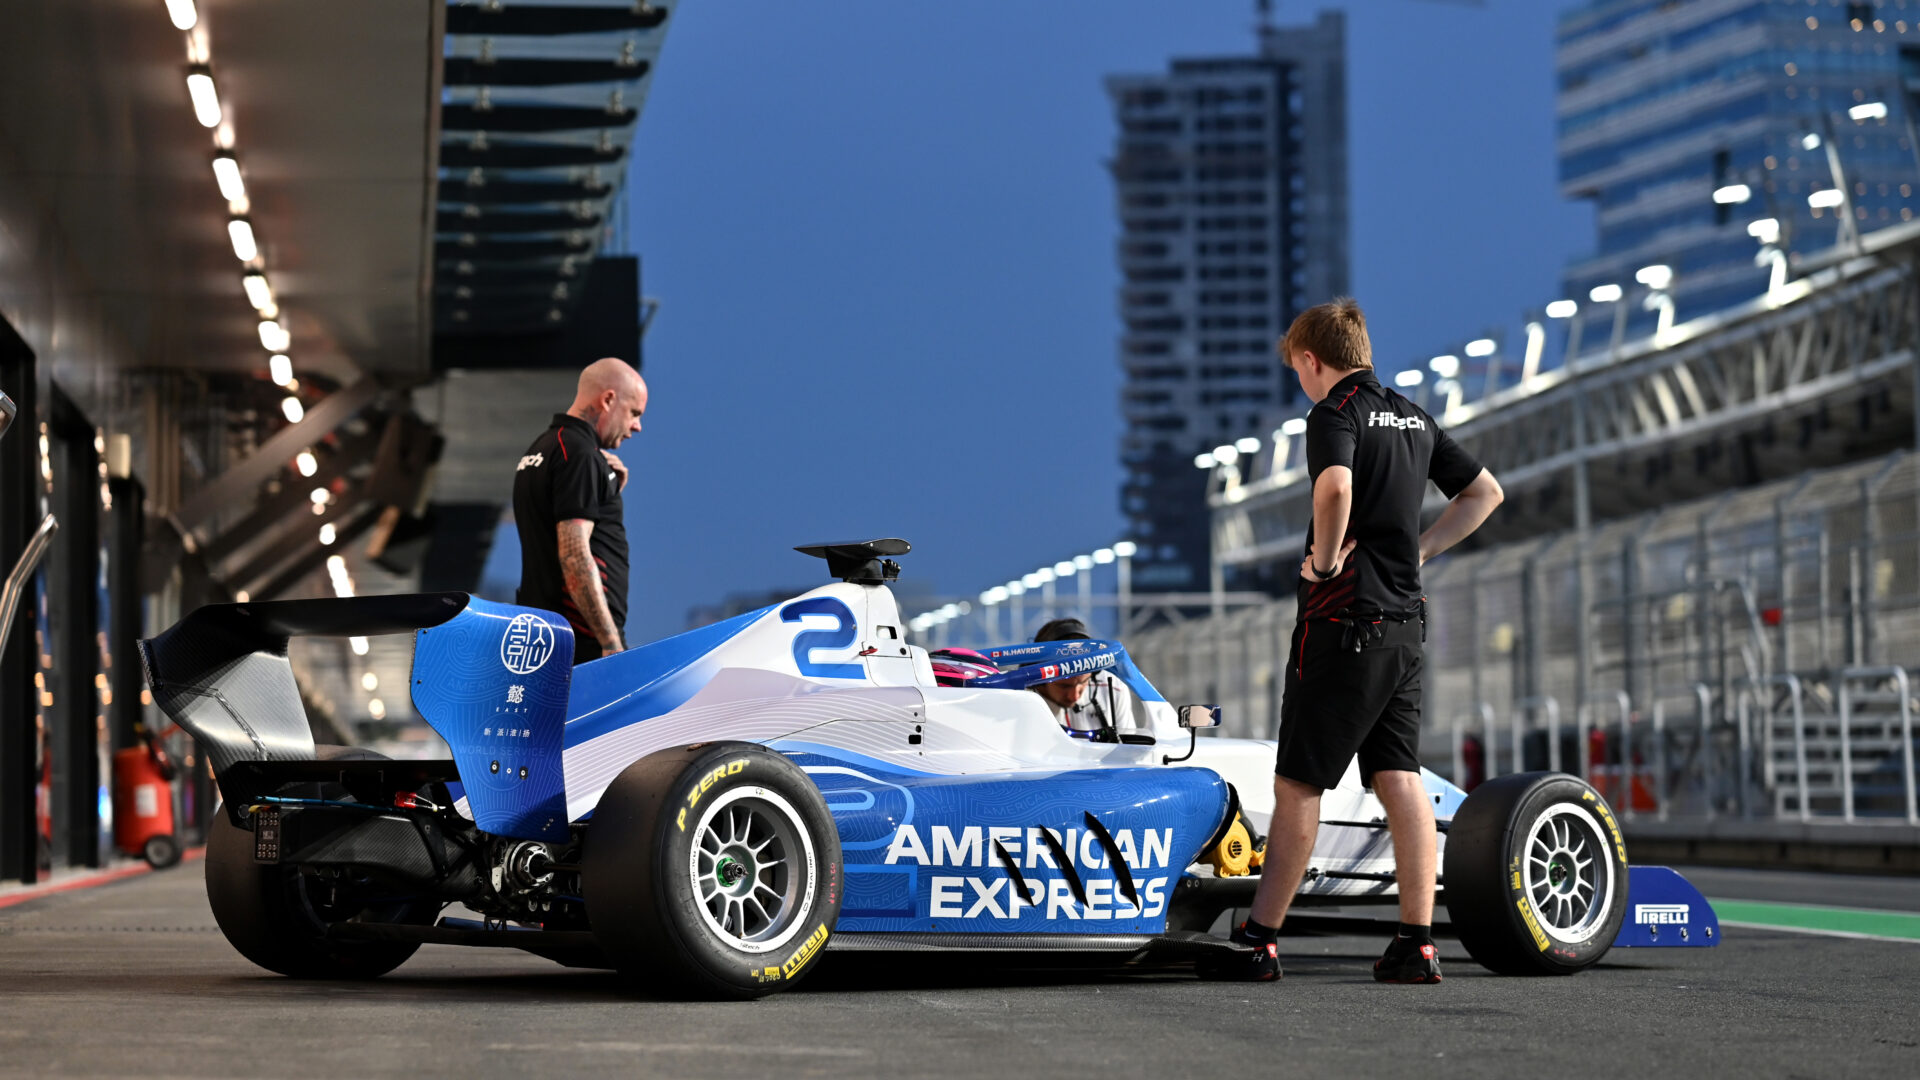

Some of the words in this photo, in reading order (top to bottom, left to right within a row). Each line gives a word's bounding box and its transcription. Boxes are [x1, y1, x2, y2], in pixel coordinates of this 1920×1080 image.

[1368, 411, 1425, 431] Hitech
[780, 596, 867, 680] 2
[1002, 647, 1041, 657] N.HAVRDA
[1060, 653, 1115, 676] N.HAVRDA
[676, 806, 688, 832] P
[688, 759, 746, 809] ZERO
[884, 824, 1173, 869] AMERICAN
[1582, 790, 1596, 801] P
[1595, 802, 1627, 863] ZERO
[929, 876, 1168, 920] EXPRESS
[1635, 904, 1689, 924] PIRELLI
[782, 922, 829, 980] PIRELLI
